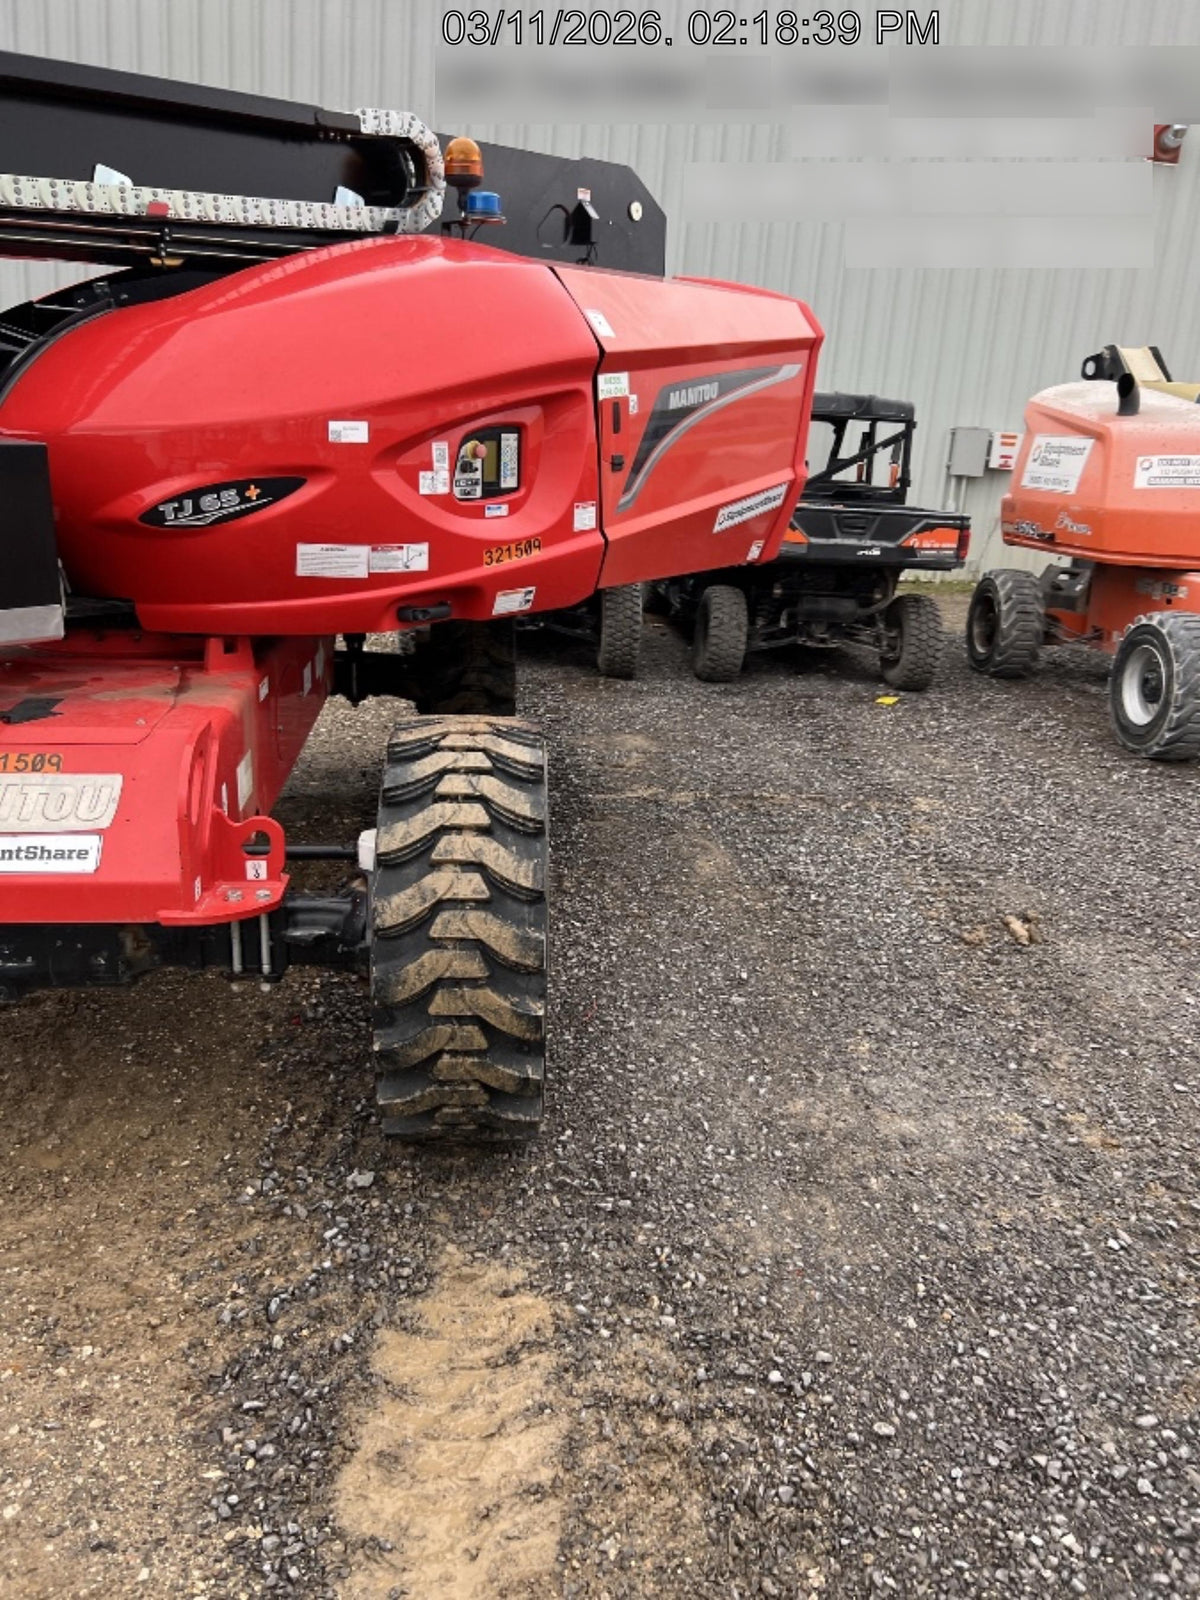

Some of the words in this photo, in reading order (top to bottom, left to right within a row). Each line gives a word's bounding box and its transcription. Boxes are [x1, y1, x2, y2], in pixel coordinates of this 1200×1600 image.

[669, 382, 719, 410] MANITOU
[158, 499, 193, 520] TJ
[199, 488, 241, 512] 65
[484, 537, 542, 566] 321509
[0, 845, 89, 861] ntShare
